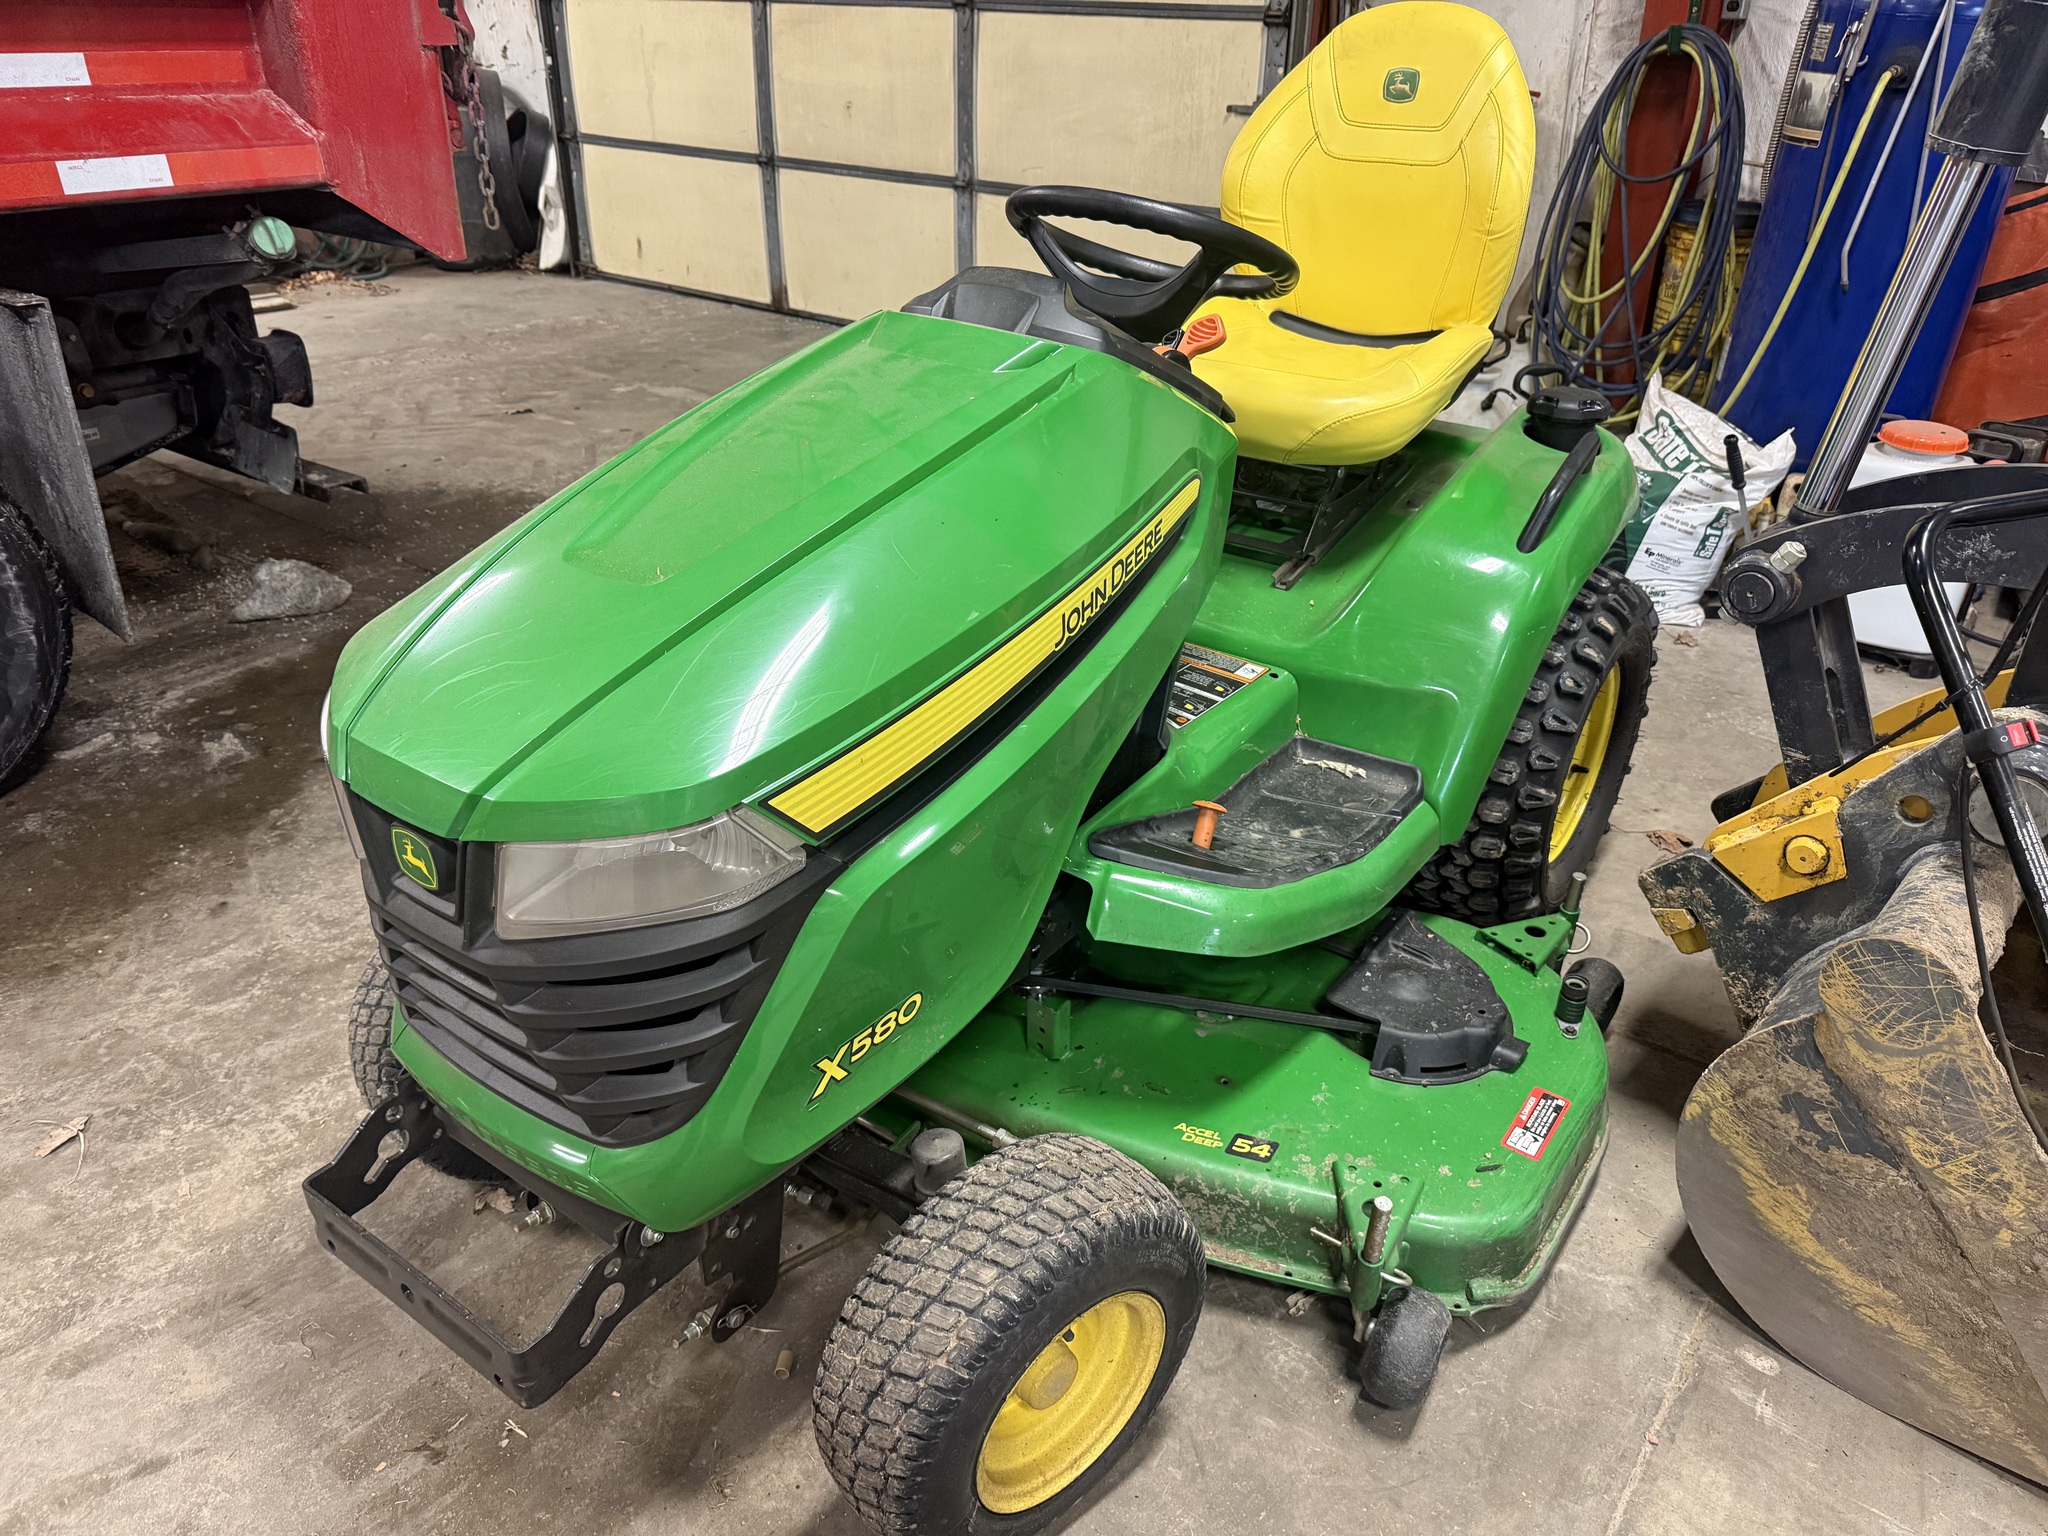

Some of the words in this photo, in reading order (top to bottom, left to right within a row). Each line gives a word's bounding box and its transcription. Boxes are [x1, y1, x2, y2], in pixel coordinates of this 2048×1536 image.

[1706, 527, 1721, 536] T
[1699, 536, 1720, 558] Safe
[1655, 550, 1682, 565] Minerals
[1054, 578, 1108, 650] JOHN
[1111, 518, 1164, 595] DEERE
[808, 991, 923, 1102] X580
[1173, 1122, 1222, 1140] ACCEL
[1181, 1132, 1224, 1148] DEEP
[1232, 1138, 1271, 1158] 54
